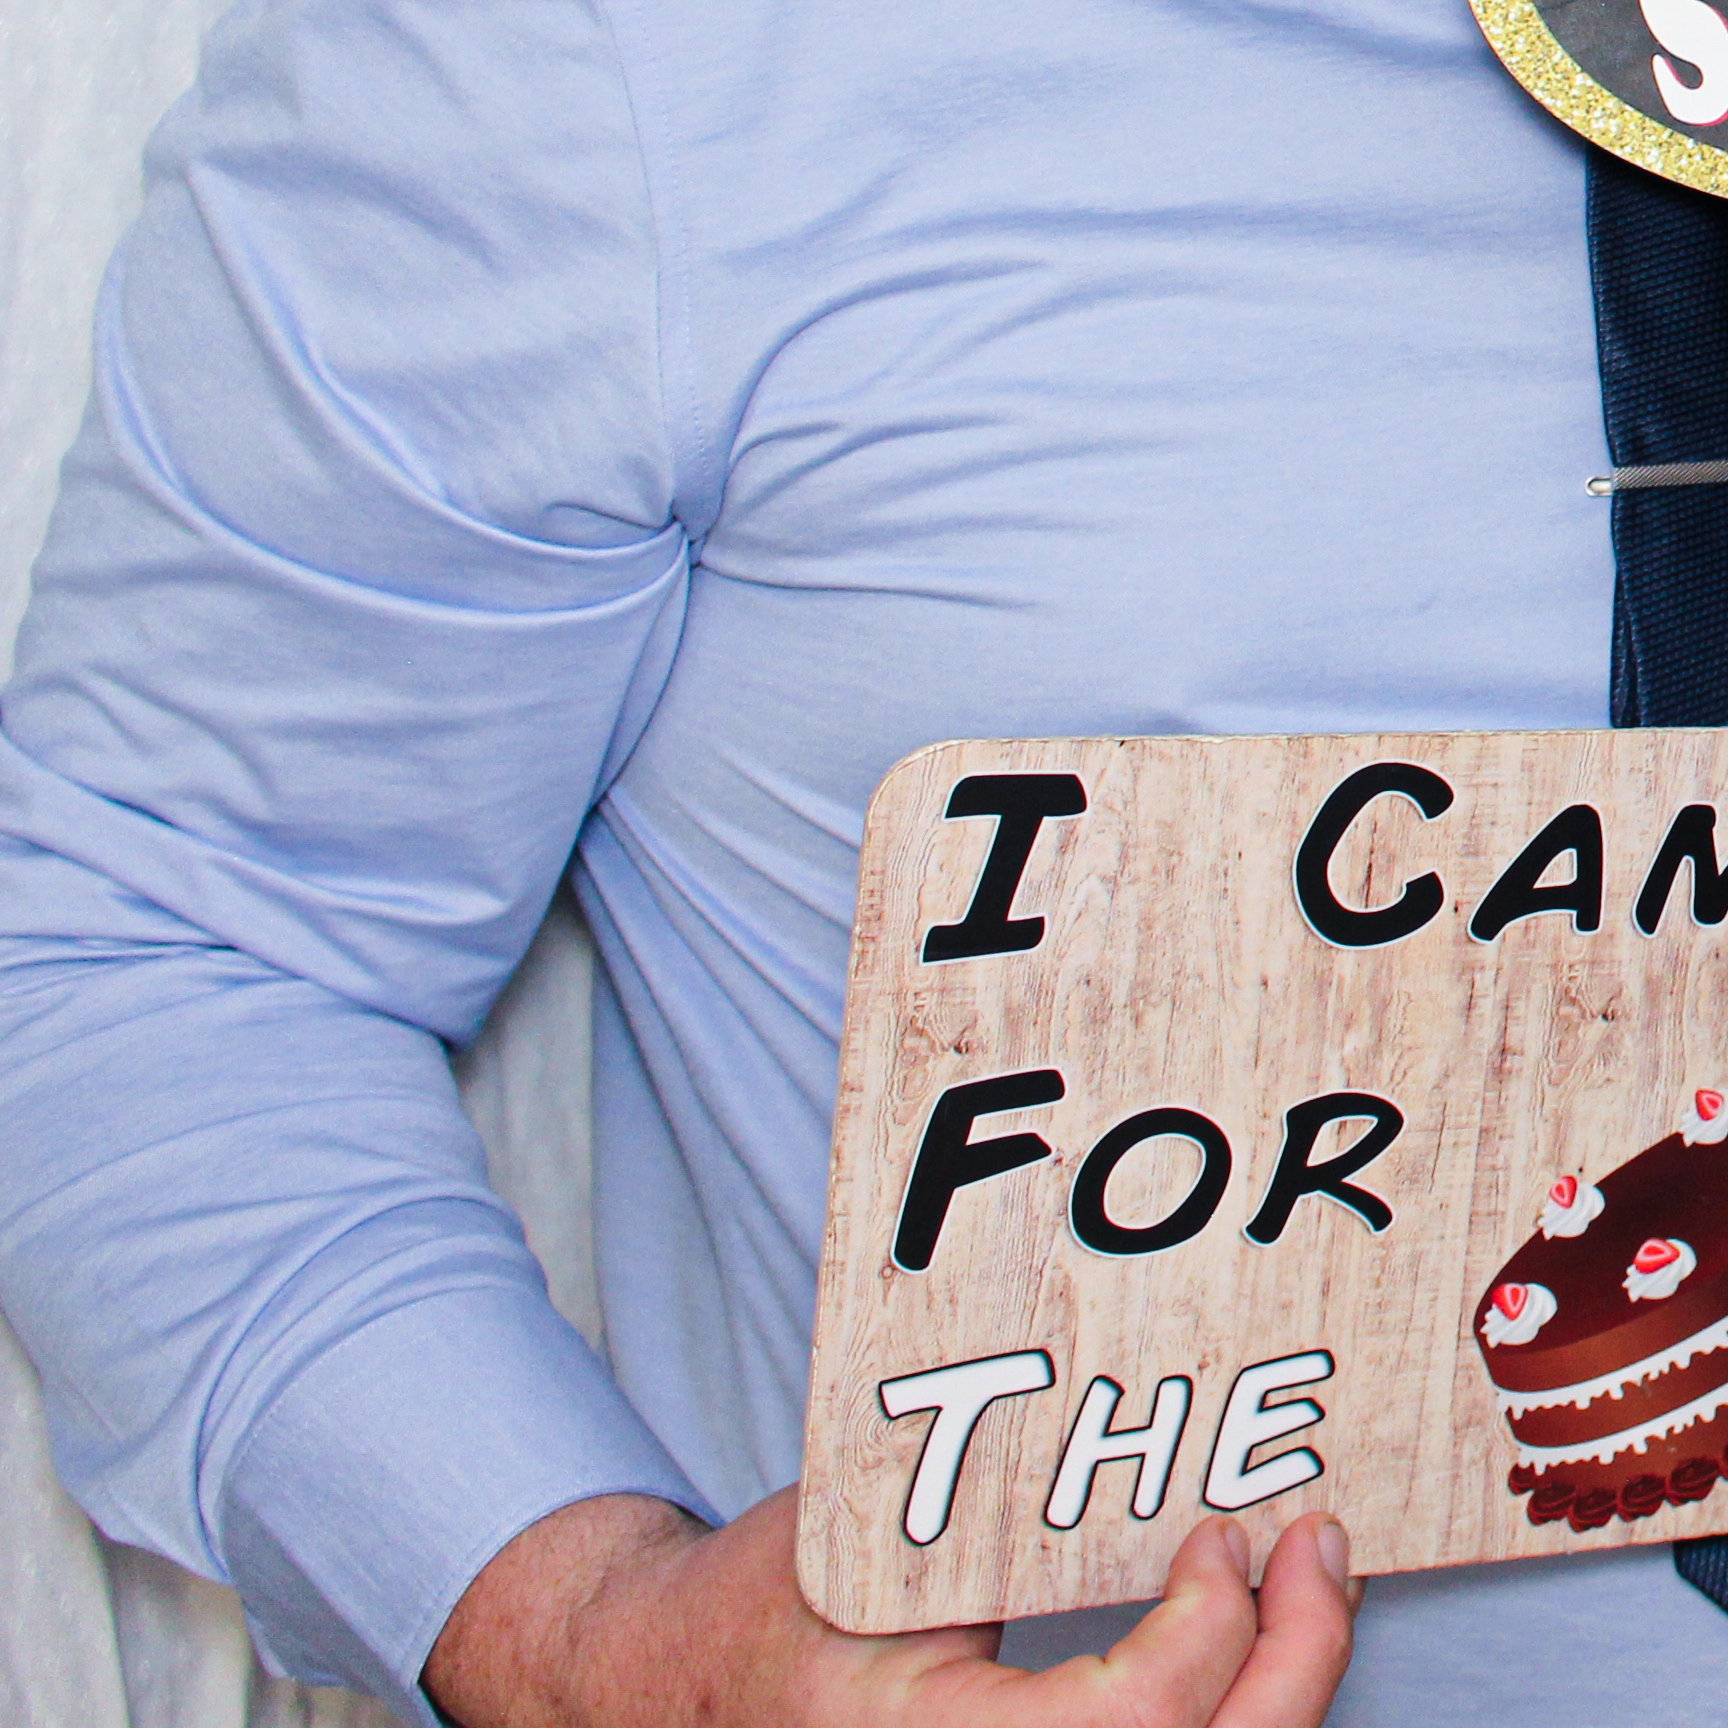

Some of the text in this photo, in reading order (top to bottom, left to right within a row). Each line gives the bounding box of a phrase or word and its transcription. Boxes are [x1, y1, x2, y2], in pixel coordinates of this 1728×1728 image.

[919, 771, 1089, 964] I
[889, 1067, 1406, 1273] FOR
[877, 1347, 1335, 1548] THE
